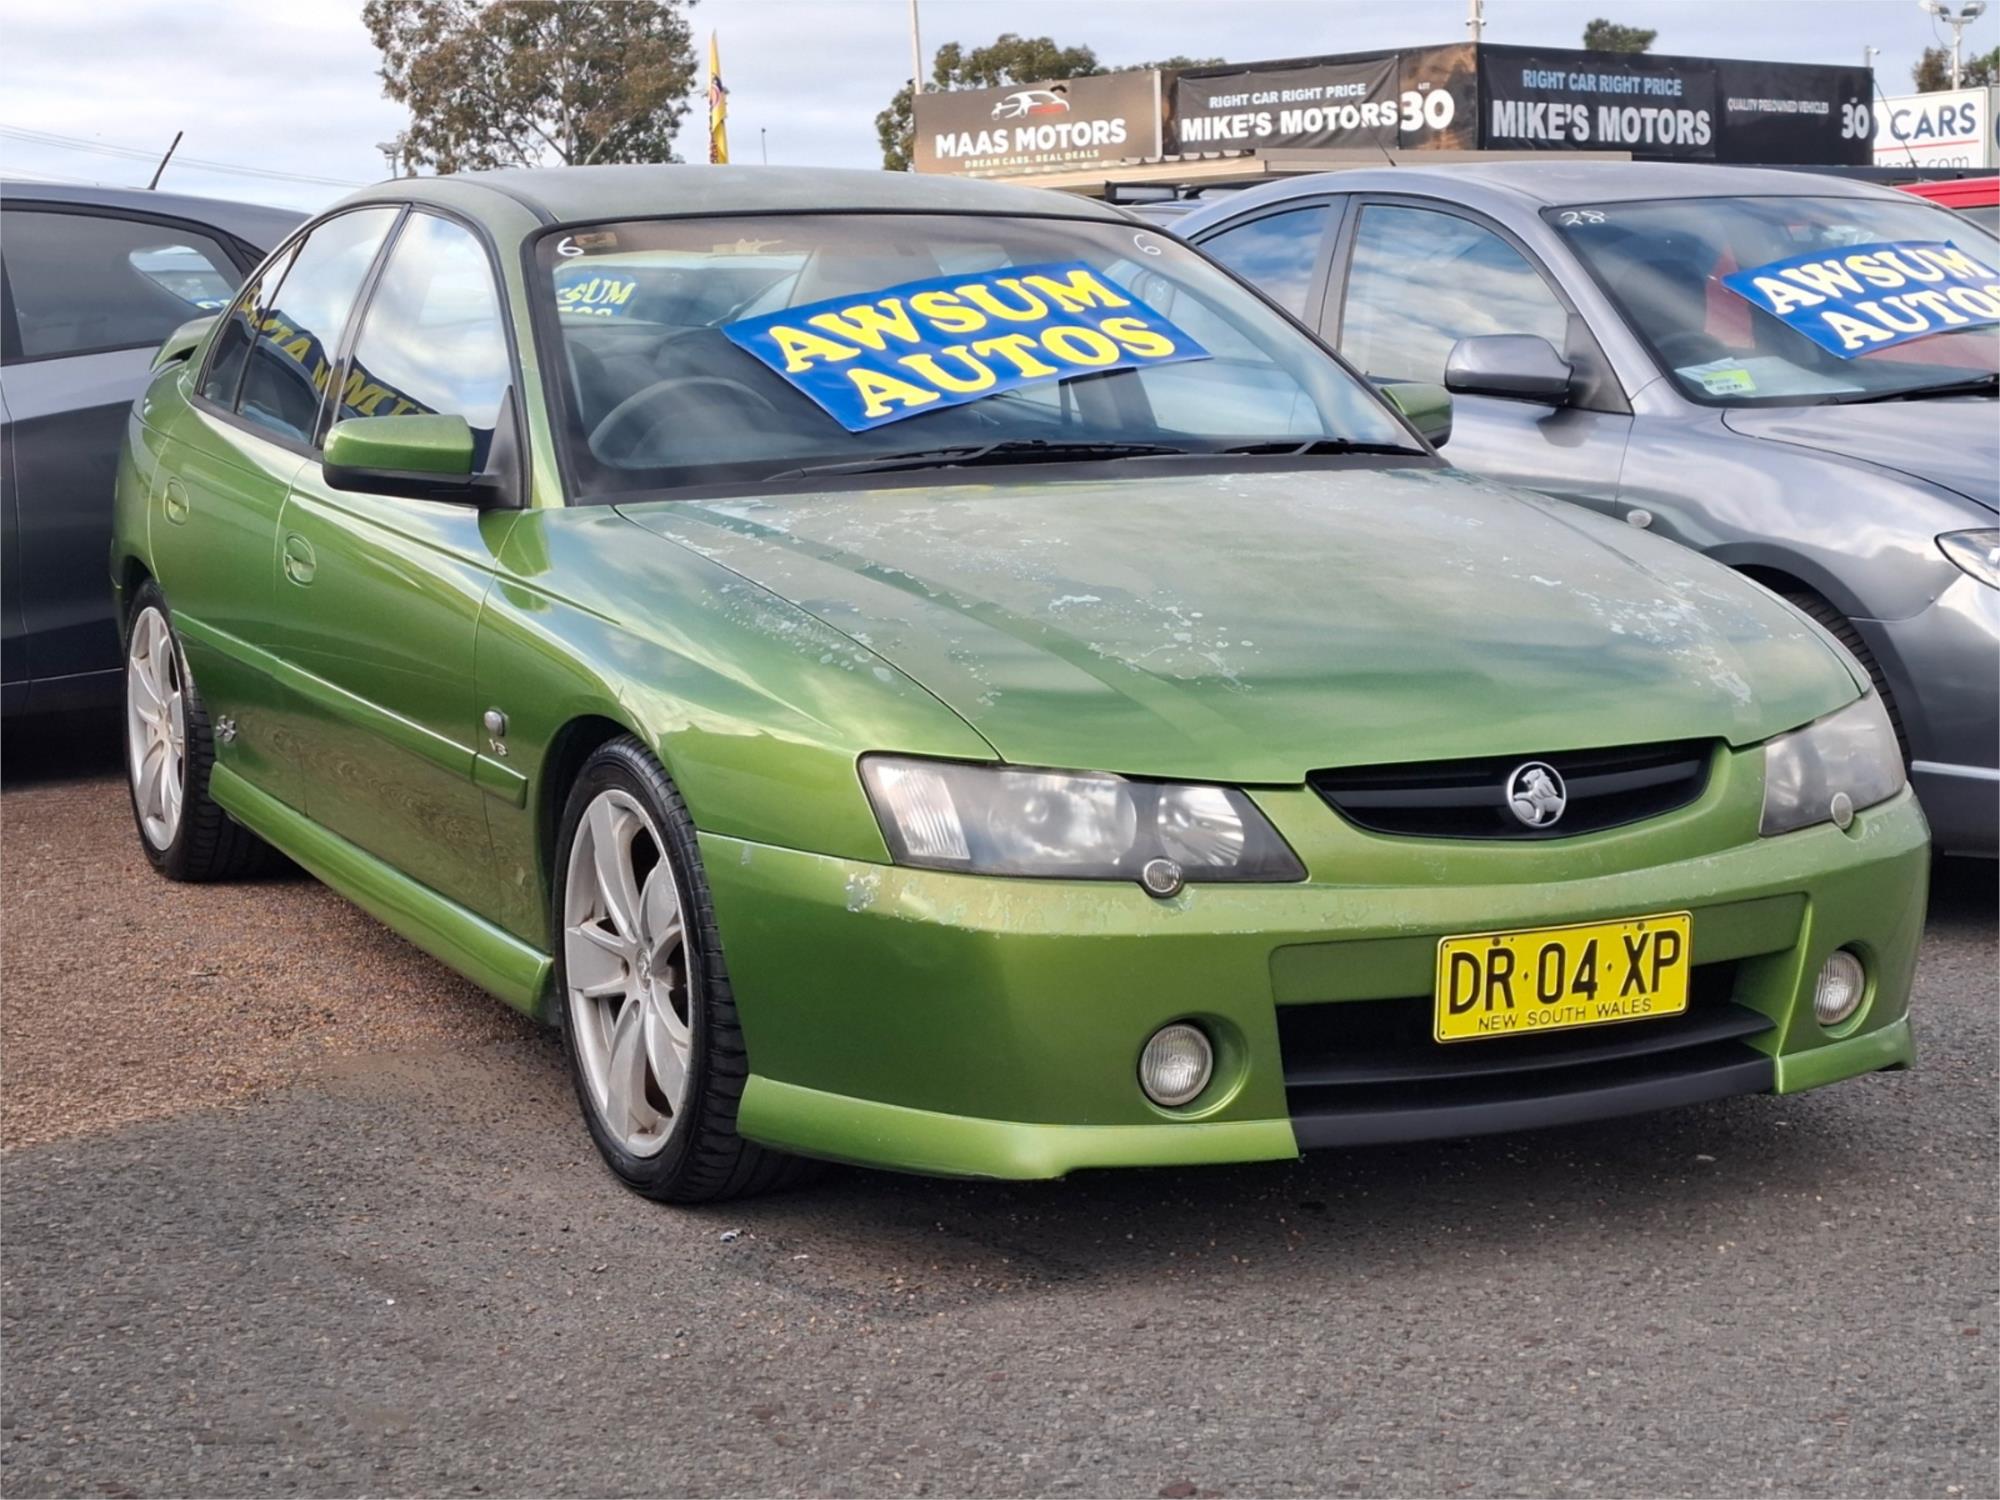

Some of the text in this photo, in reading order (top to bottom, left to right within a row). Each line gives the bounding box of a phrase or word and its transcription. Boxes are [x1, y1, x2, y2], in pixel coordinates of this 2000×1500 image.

[1209, 83, 1366, 108] RIGHT CAR RIGHT PRICE
[1522, 69, 1682, 96] RIGHT CAR RIGHT PRICE
[1181, 100, 1398, 142] MIKE'S MOTORS
[1400, 88, 1455, 131] 30
[1492, 99, 1712, 146] MIKE'S MOTORS
[1841, 103, 1870, 139] 30
[1890, 102, 1976, 140] CARS
[935, 118, 1127, 158] MAAS MOTORS
[965, 157, 1000, 168] DREAM
[1036, 152, 1062, 163] REAL
[1065, 149, 1099, 160] DEALS
[1560, 210, 1605, 226] 28
[557, 236, 585, 257] 6
[1133, 233, 1161, 255] 6
[556, 277, 637, 305] SUM
[1753, 248, 1997, 315] AWSUM
[768, 269, 1131, 374] AWSUM
[845, 316, 1175, 418] AUTOS
[1478, 998, 1651, 1032] NEW SOUTH WALES
